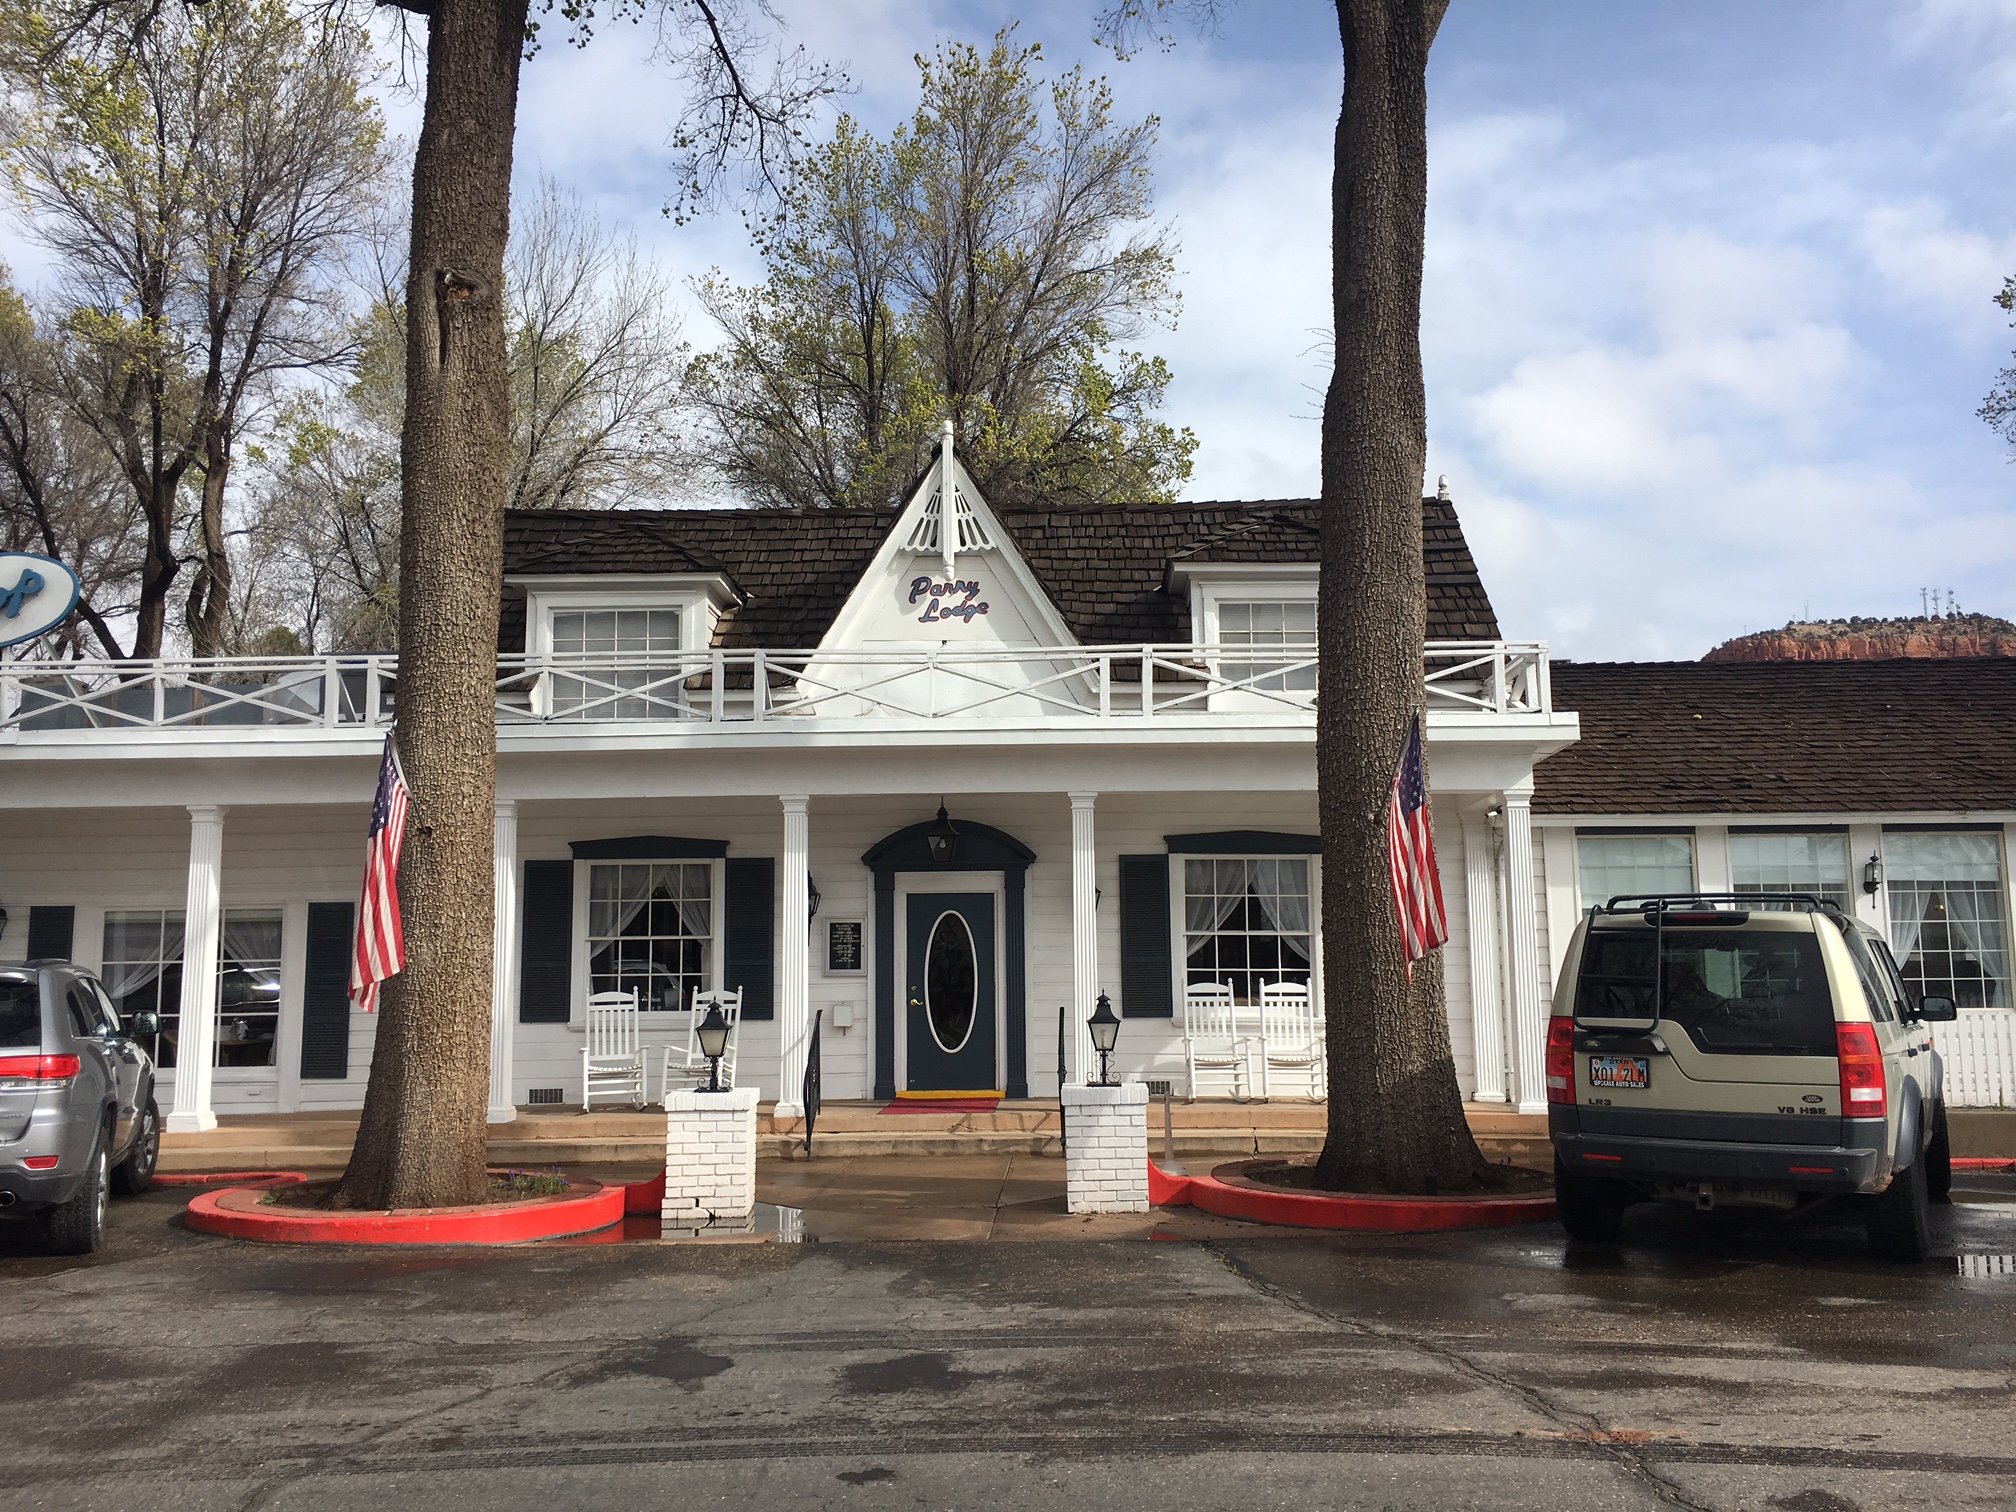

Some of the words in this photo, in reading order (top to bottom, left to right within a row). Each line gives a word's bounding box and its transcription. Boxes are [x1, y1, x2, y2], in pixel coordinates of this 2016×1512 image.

[908, 576, 980, 604] Parry
[918, 598, 989, 623] Lodge
[1777, 1106, 1795, 1114] V8
[1799, 1107, 1827, 1115] HSE
